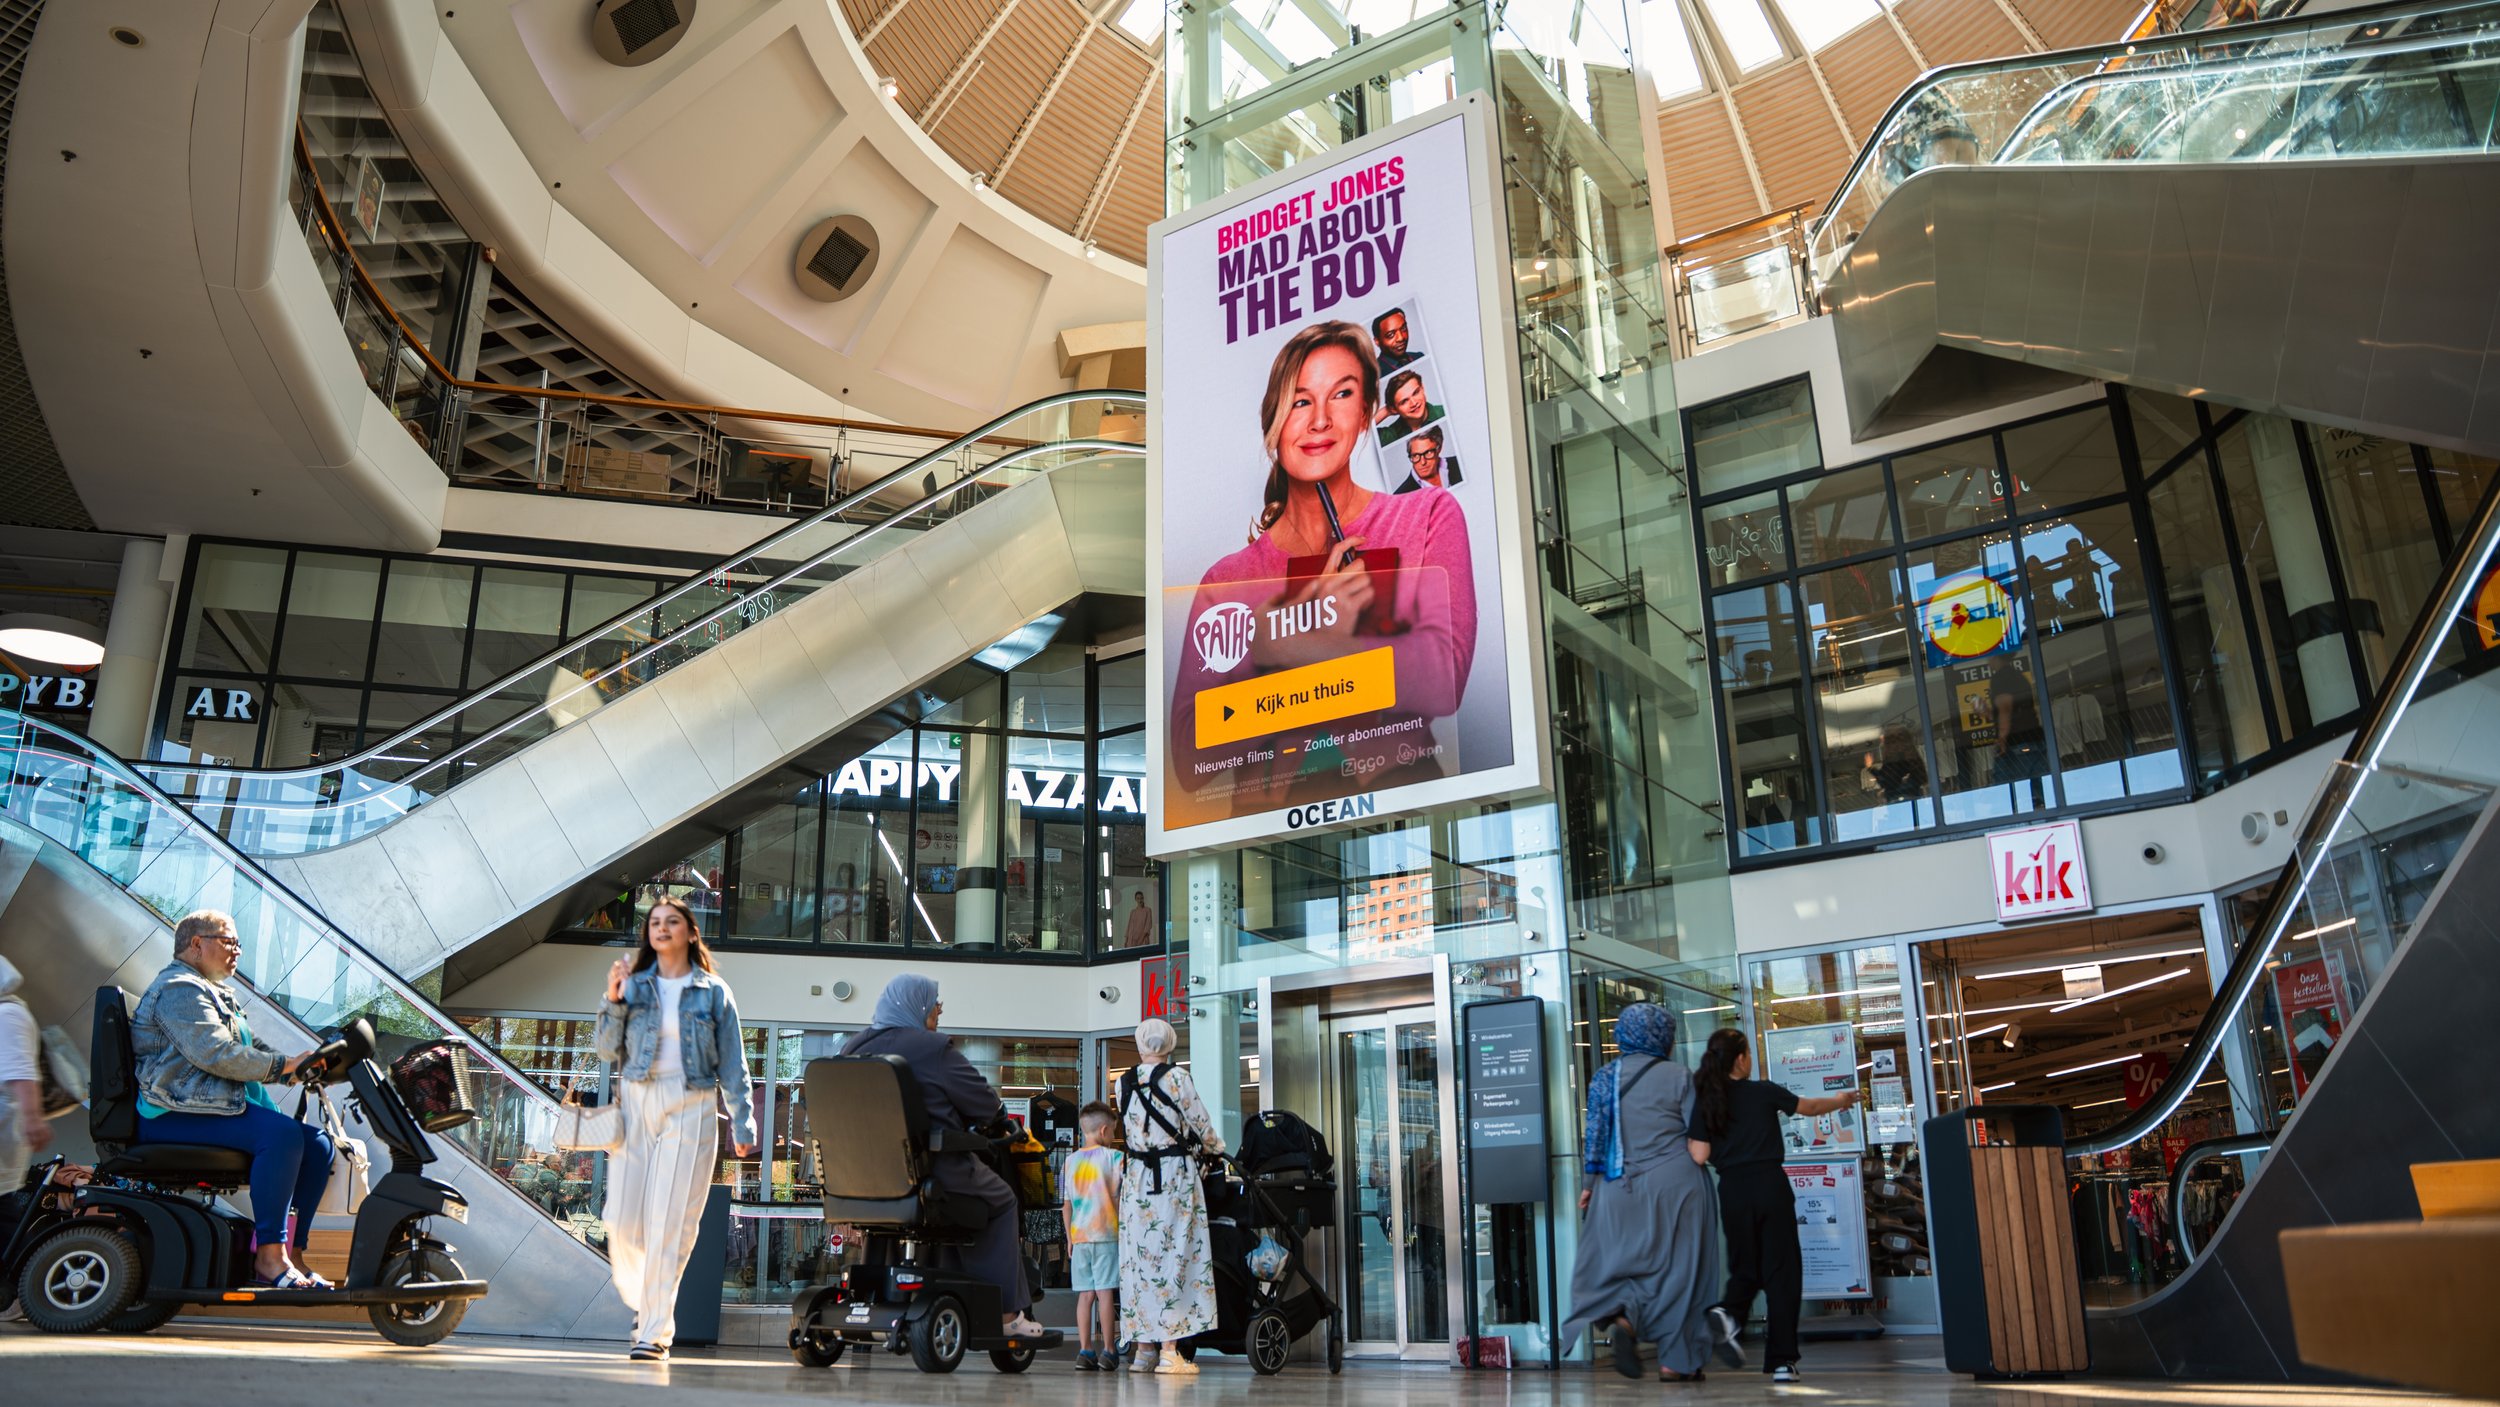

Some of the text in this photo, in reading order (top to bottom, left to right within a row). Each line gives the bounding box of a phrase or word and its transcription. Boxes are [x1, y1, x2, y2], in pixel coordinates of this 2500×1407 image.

[1218, 156, 1405, 255] BRIDGET JONES
[1218, 186, 1406, 293] MAD ABOUT
[1219, 225, 1407, 345] THE BOY
[1267, 595, 1338, 640] THUIS
[0, 673, 94, 708] PYB
[1255, 678, 1355, 715] Kijk nu thuis
[1194, 717, 1424, 775] Nieuwste films Zonder abonnement
[1418, 744, 1444, 760] kpn
[802, 758, 1147, 814] APPY AZAA
[1287, 793, 1375, 829] OCEAN
[2005, 836, 2075, 908] kik
[1471, 1033, 1477, 1042] 2
[1473, 1092, 1478, 1101] 1
[1473, 1121, 1480, 1130] 0
[2166, 1139, 2185, 1147] SALE
